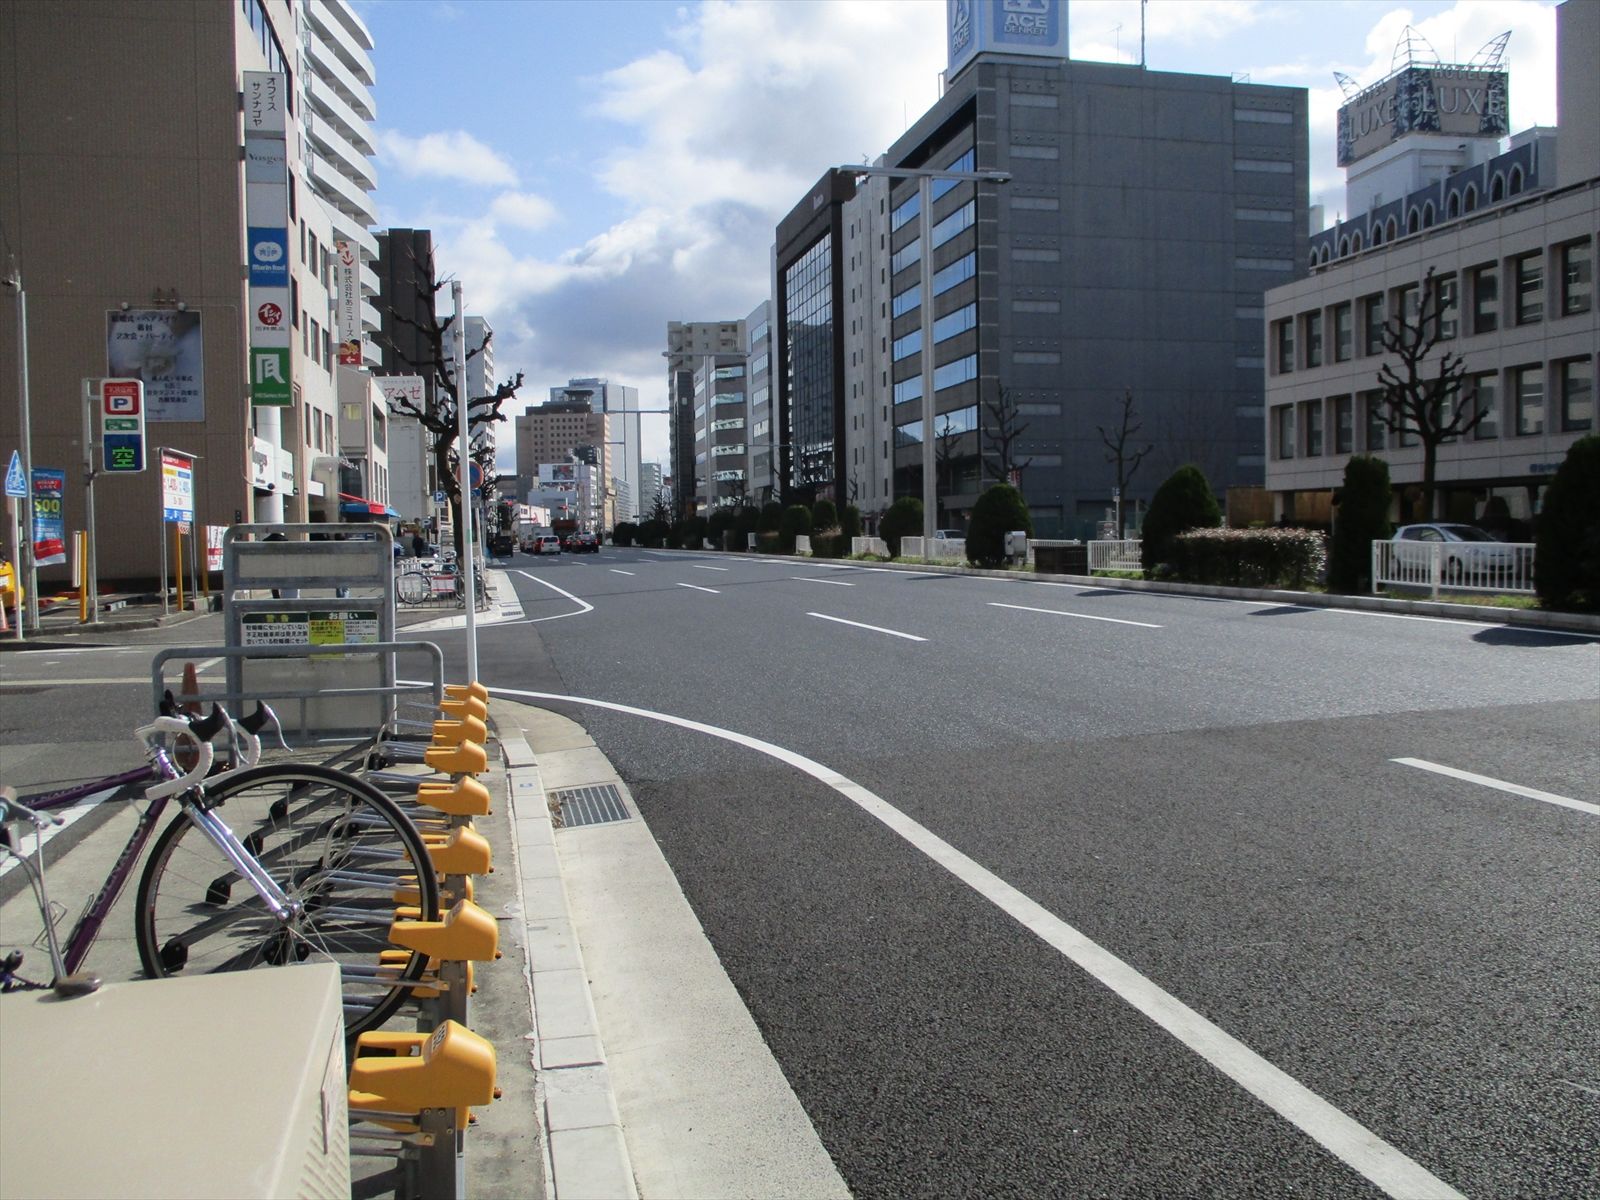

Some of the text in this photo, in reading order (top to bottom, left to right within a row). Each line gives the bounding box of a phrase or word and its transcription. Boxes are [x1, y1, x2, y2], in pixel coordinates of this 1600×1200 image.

[1004, 23, 1048, 35] DENKEN
[1005, 13, 1047, 27] ACE
[1434, 64, 1487, 81] HOTEL
[266, 77, 277, 111] オフィス
[1422, 87, 1502, 115] LUXE
[252, 82, 262, 126] サンナゴヤ
[1348, 95, 1396, 143] LUXE
[113, 398, 129, 409] P
[112, 446, 135, 467] 空
[329, 612, 359, 620] お願い
